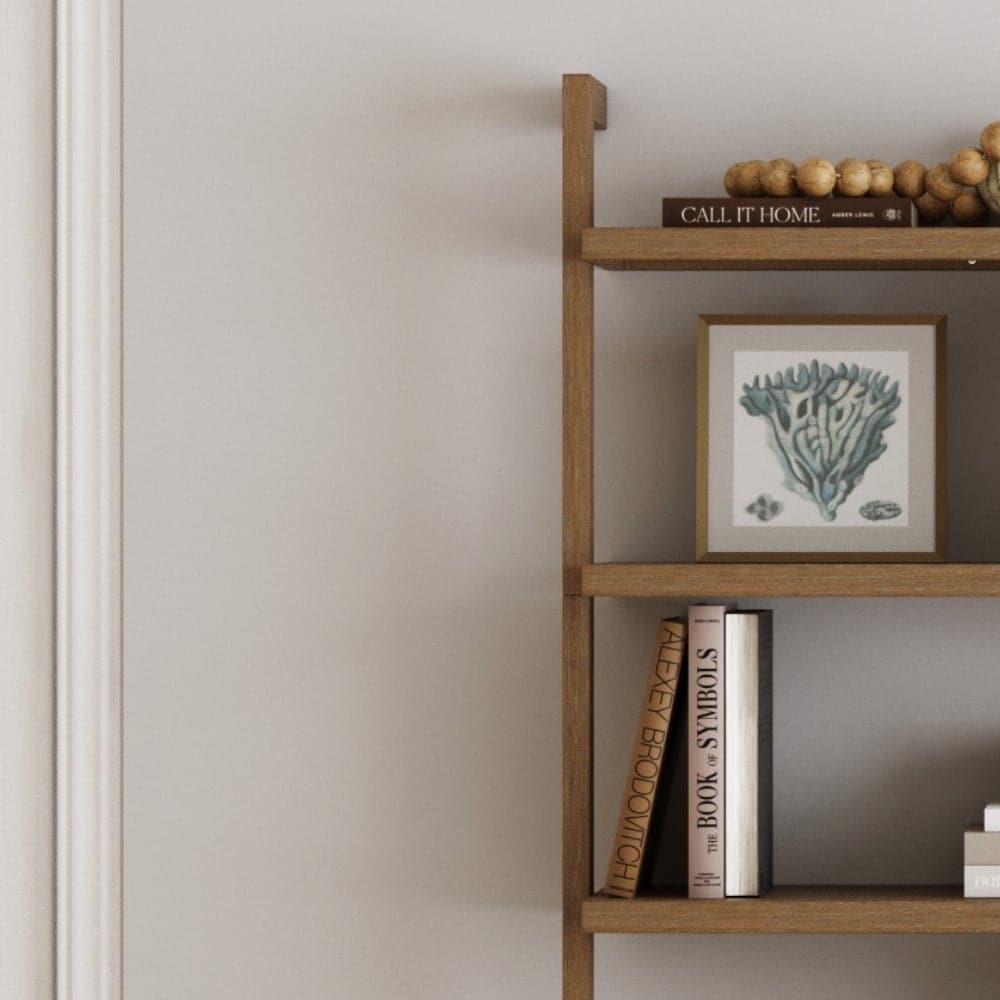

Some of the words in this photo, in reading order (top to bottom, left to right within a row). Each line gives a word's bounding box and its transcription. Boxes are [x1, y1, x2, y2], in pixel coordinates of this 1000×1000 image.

[681, 207, 731, 223] CALL
[737, 207, 754, 223] IT
[760, 207, 820, 223] HOME
[647, 627, 685, 722] ALEXEY
[697, 647, 718, 749] SYMBOLS
[708, 754, 718, 767] OF
[613, 726, 666, 881] BRODOVITCH
[697, 773, 718, 829] BOOK
[707, 833, 718, 854] THE
